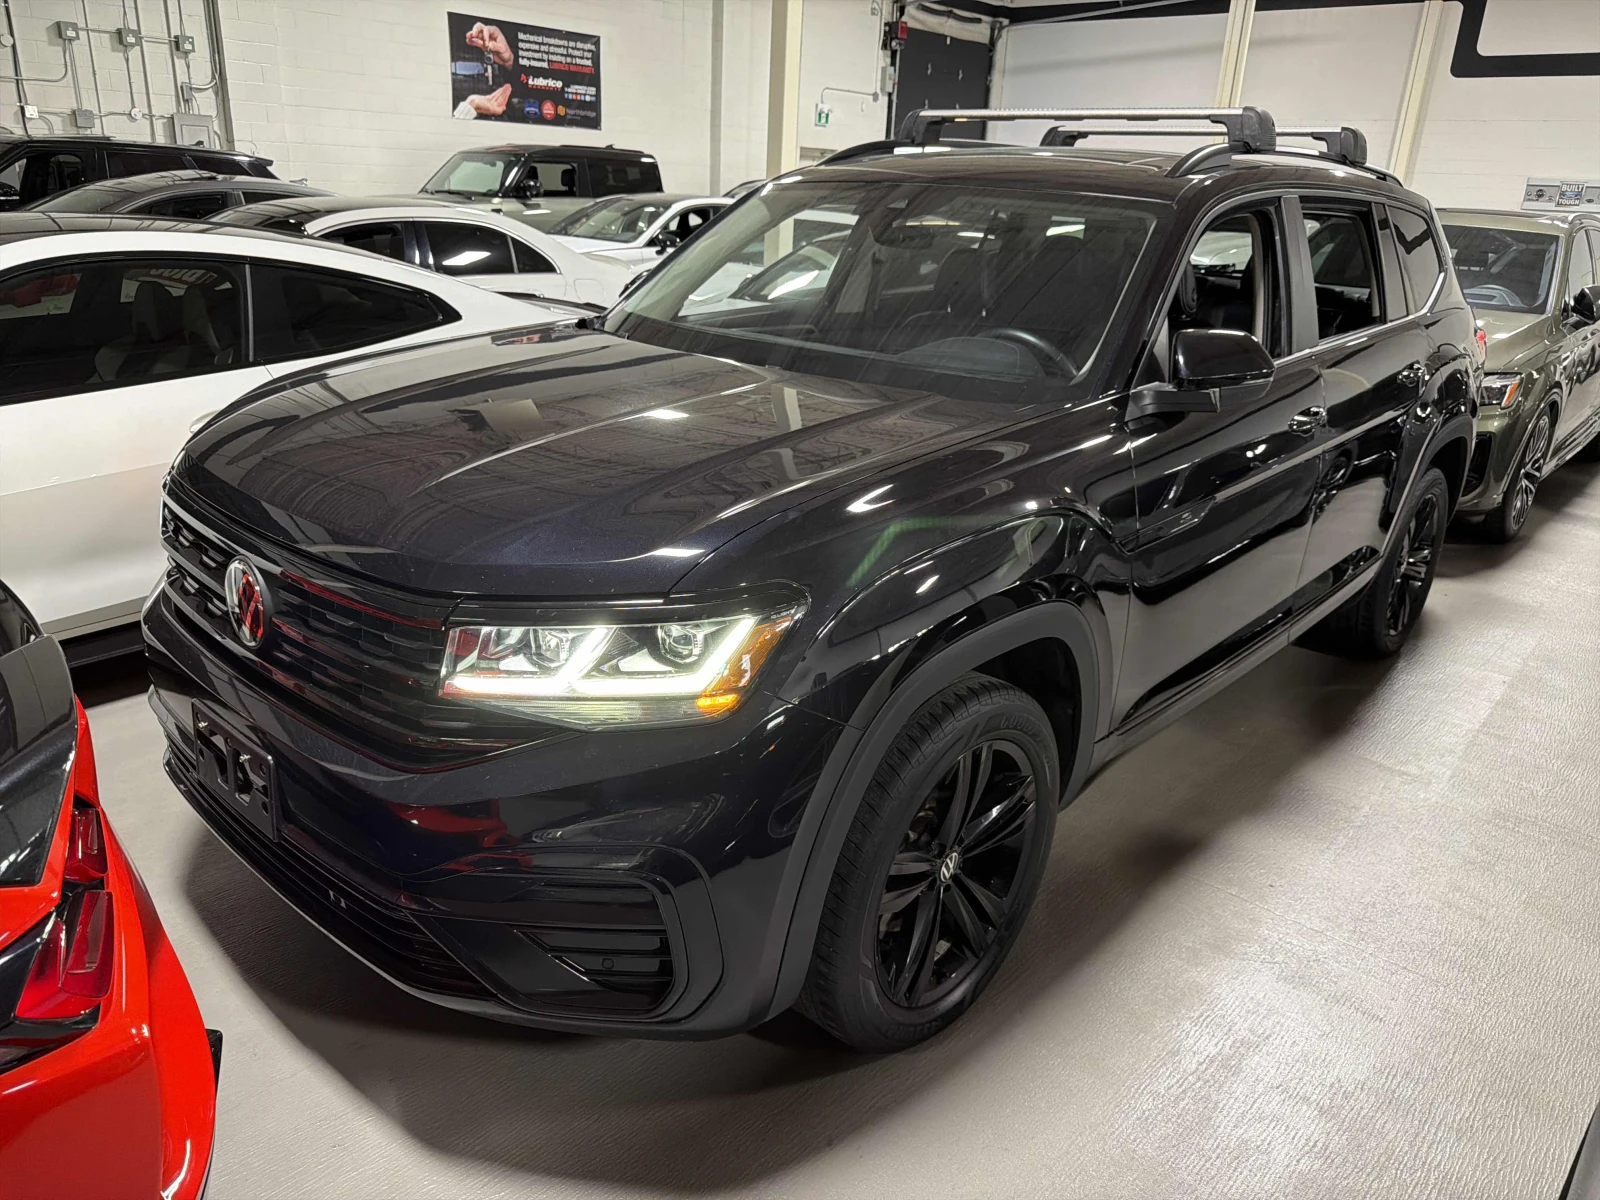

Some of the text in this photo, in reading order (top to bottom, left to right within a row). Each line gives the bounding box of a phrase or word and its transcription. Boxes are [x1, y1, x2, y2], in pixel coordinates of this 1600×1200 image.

[518, 32, 542, 42] Mechanical
[543, 36, 568, 46] breakdowns
[518, 42, 539, 50] expensive
[568, 48, 583, 56] Protect
[519, 50, 542, 59] investment
[543, 53, 548, 61] by
[550, 62, 569, 71] LUBRICO
[528, 76, 563, 88] Lubrico
